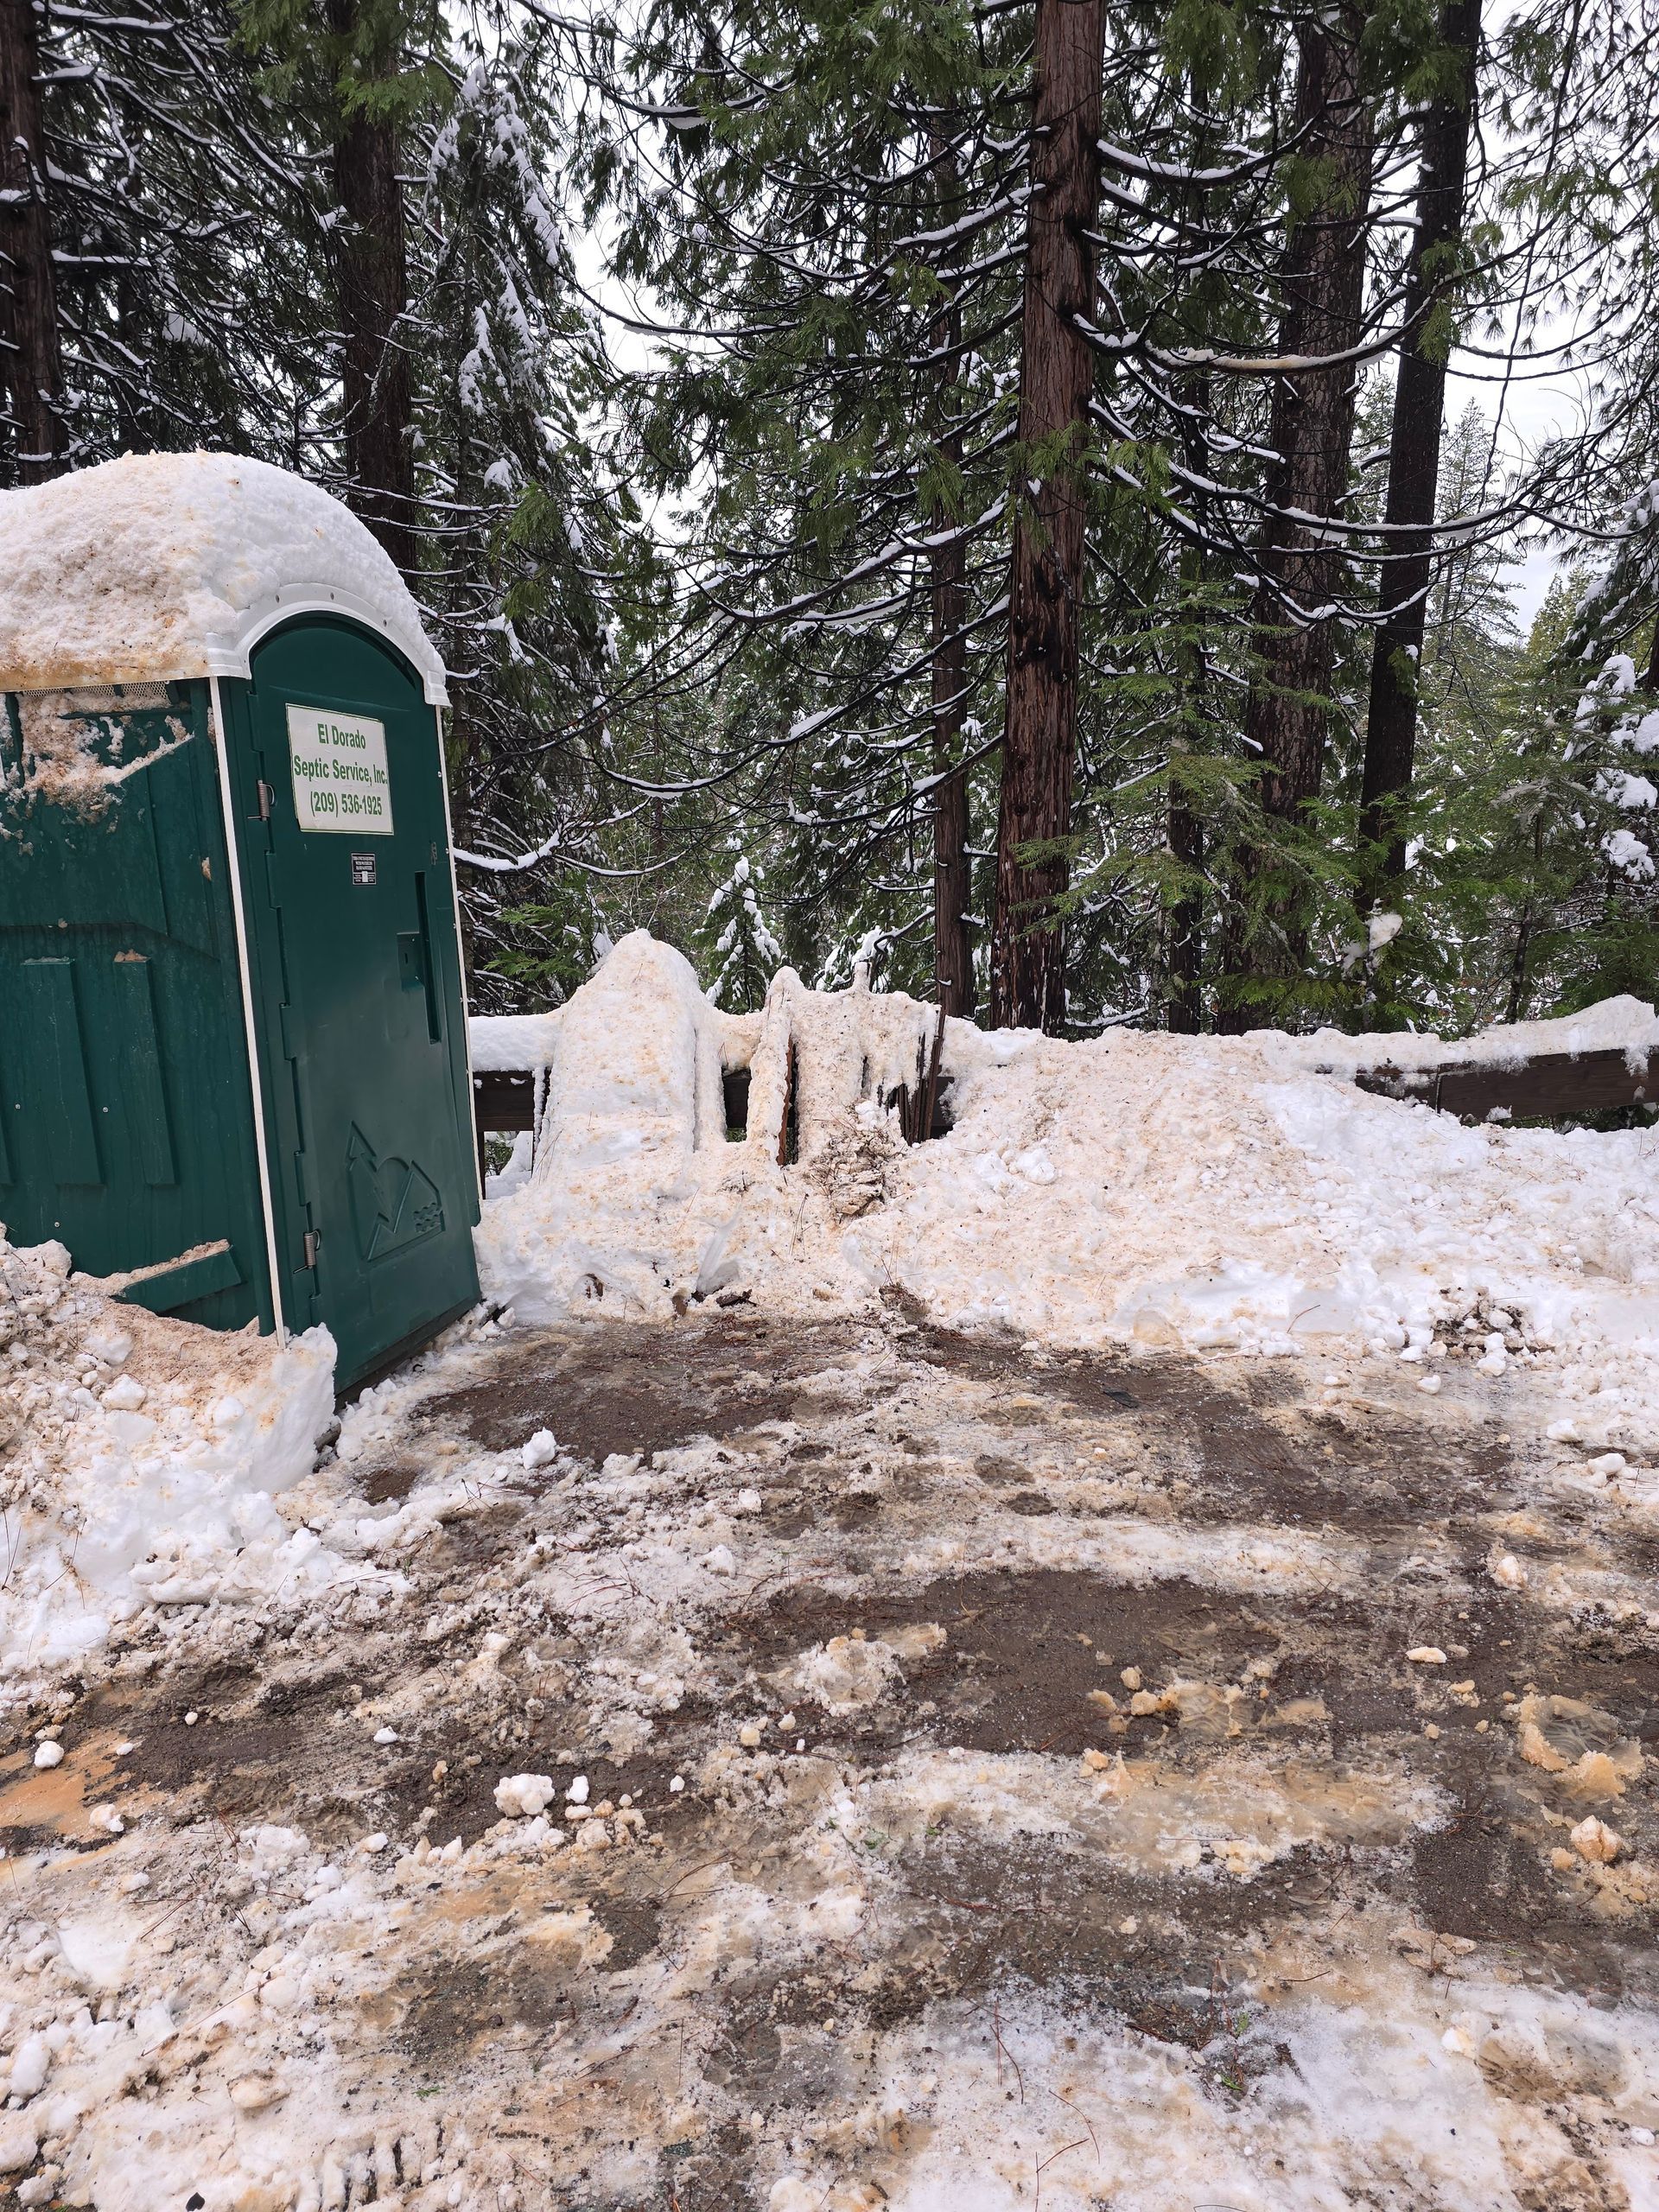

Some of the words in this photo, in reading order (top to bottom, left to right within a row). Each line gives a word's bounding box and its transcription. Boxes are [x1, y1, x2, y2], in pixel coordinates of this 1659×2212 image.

[317, 723, 329, 744] El
[331, 725, 366, 749] Dorado
[294, 755, 329, 782] Septic
[333, 759, 372, 786] Service,
[373, 764, 388, 785] Inc.
[310, 791, 339, 817] (209)
[341, 793, 382, 816] 536-1925
